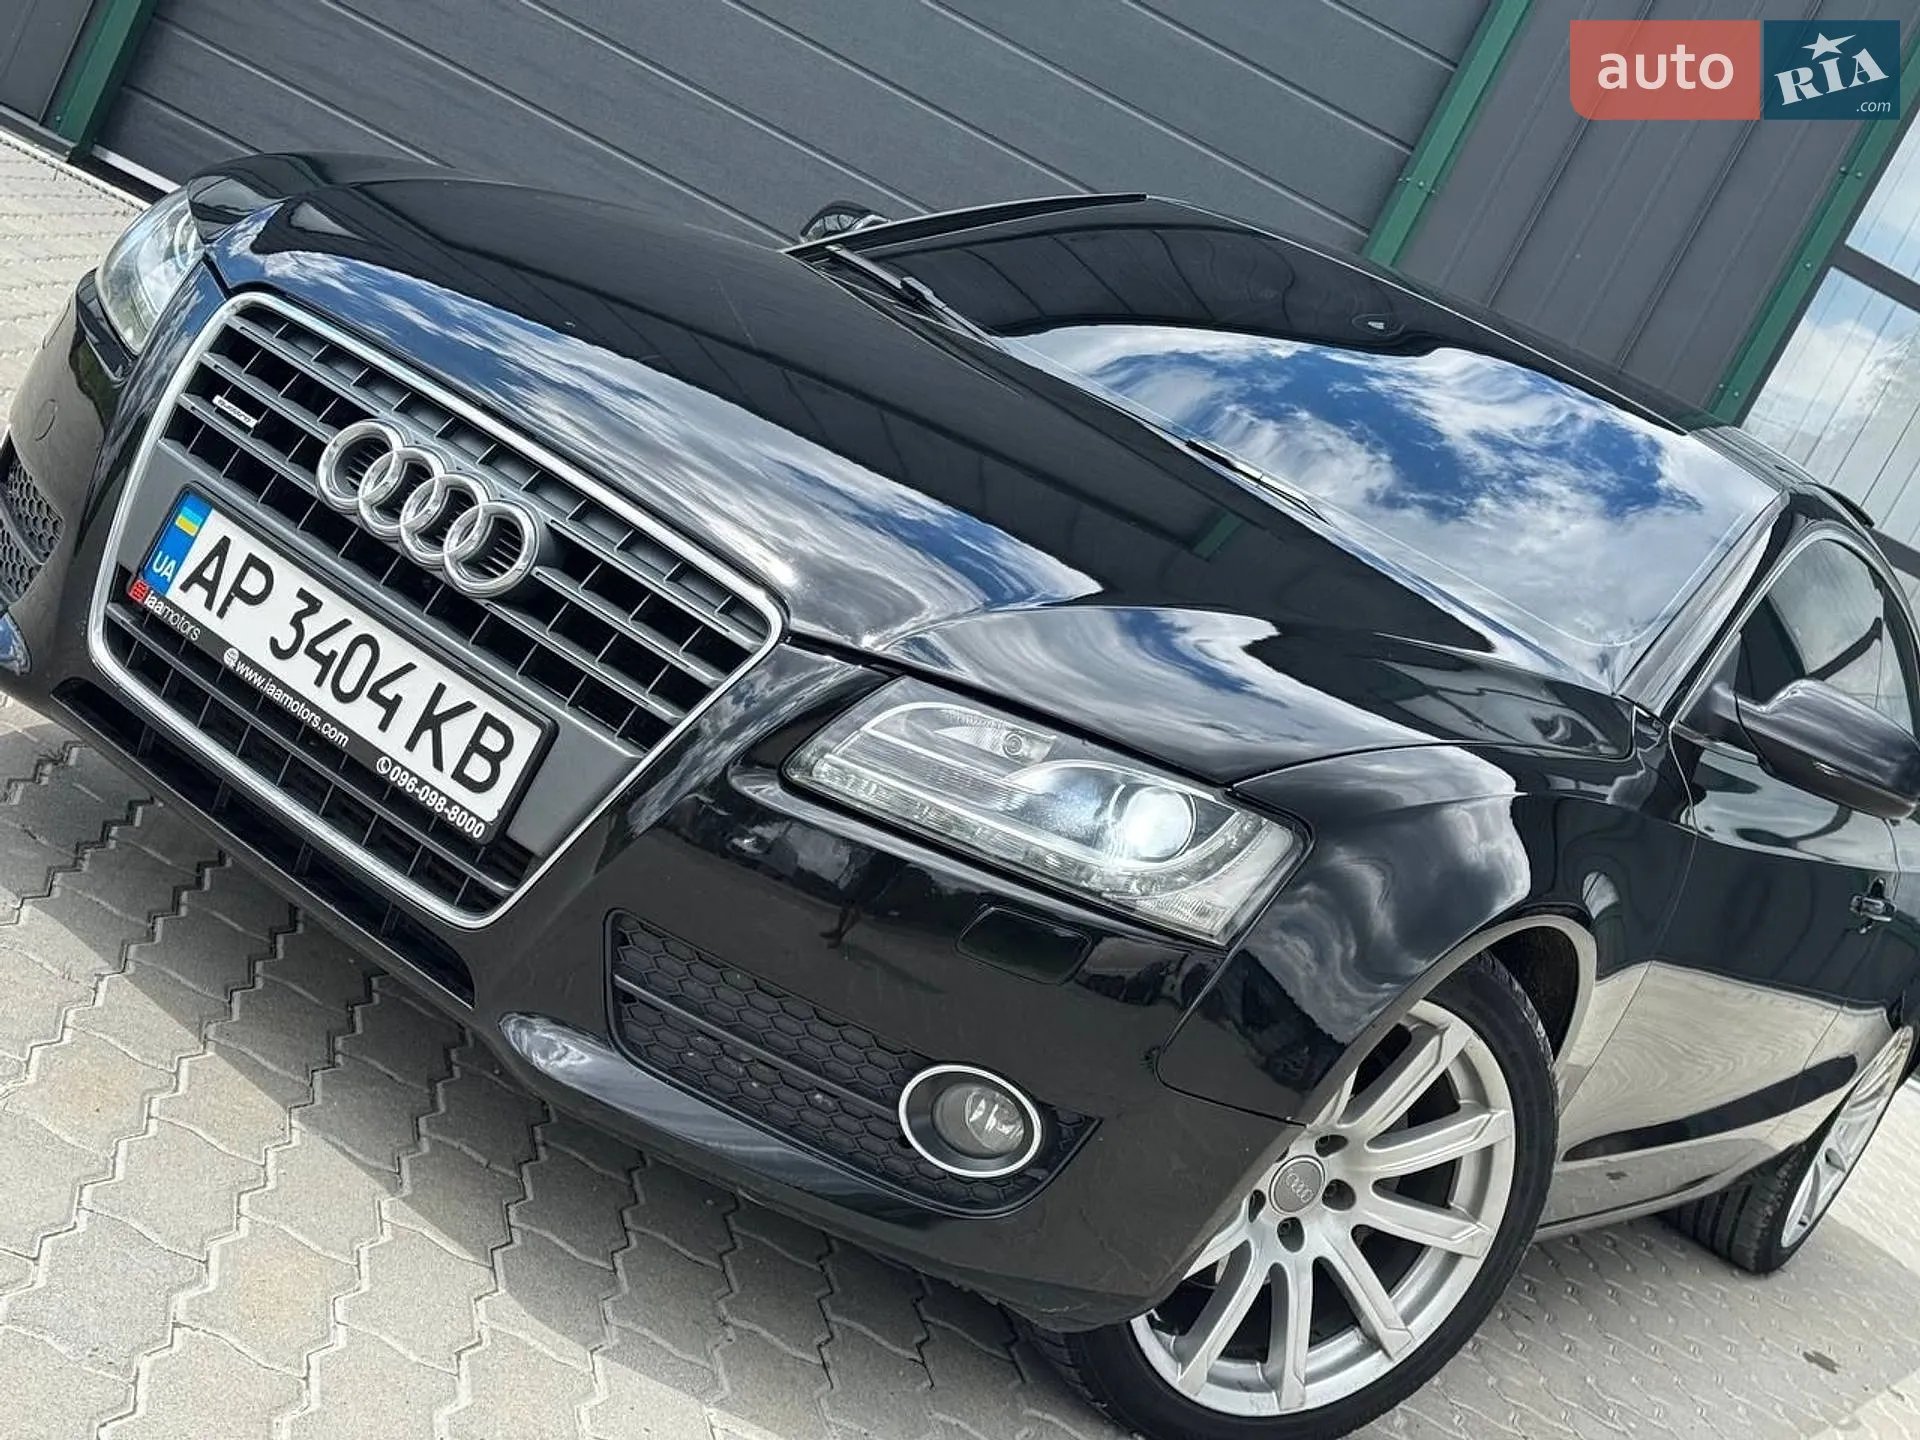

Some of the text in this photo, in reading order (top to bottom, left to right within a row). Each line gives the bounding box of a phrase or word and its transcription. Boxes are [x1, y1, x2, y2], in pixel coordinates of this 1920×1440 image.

[152, 551, 177, 583] UA
[179, 535, 515, 794] AP 3404 KB
[235, 660, 350, 748] www.iaamotors.com
[389, 766, 486, 839] 096-098-8000
